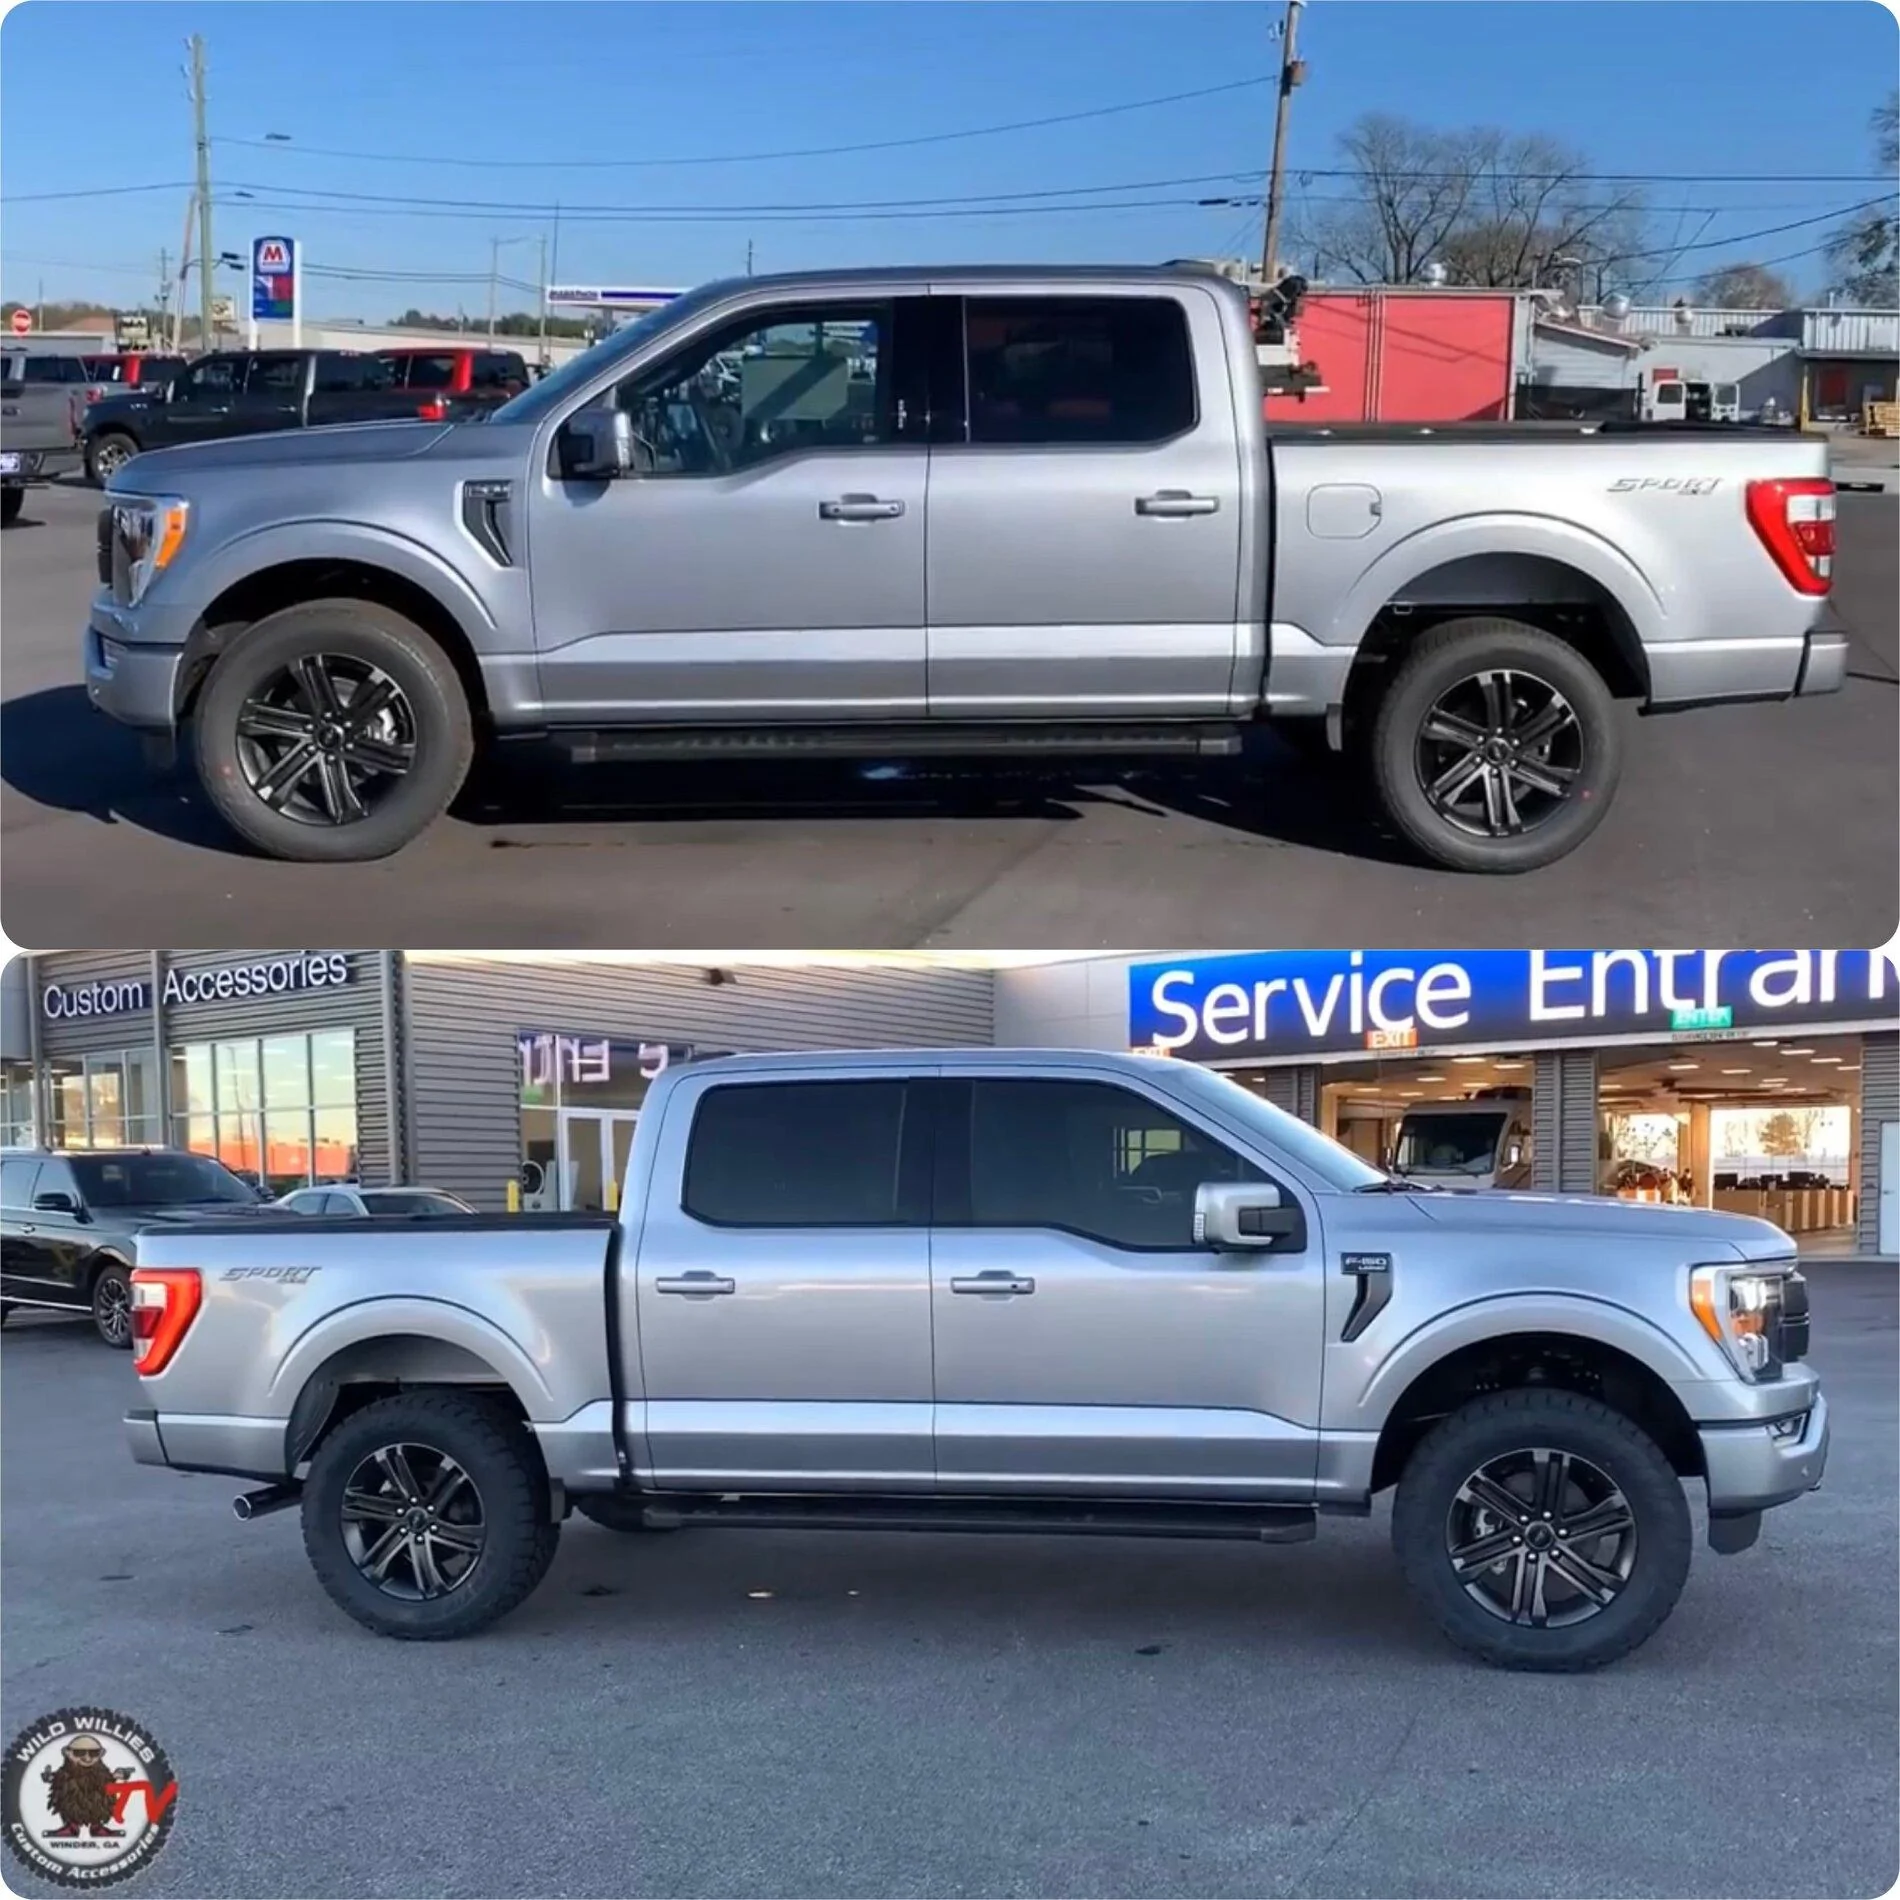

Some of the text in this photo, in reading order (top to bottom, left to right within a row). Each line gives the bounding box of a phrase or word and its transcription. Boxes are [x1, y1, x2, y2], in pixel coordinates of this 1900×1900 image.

[43, 950, 347, 1018] Custom Accessories
[1152, 951, 1471, 1048] Service
[1372, 1029, 1413, 1048] EXIT
[219, 1266, 322, 1281] SPORT
